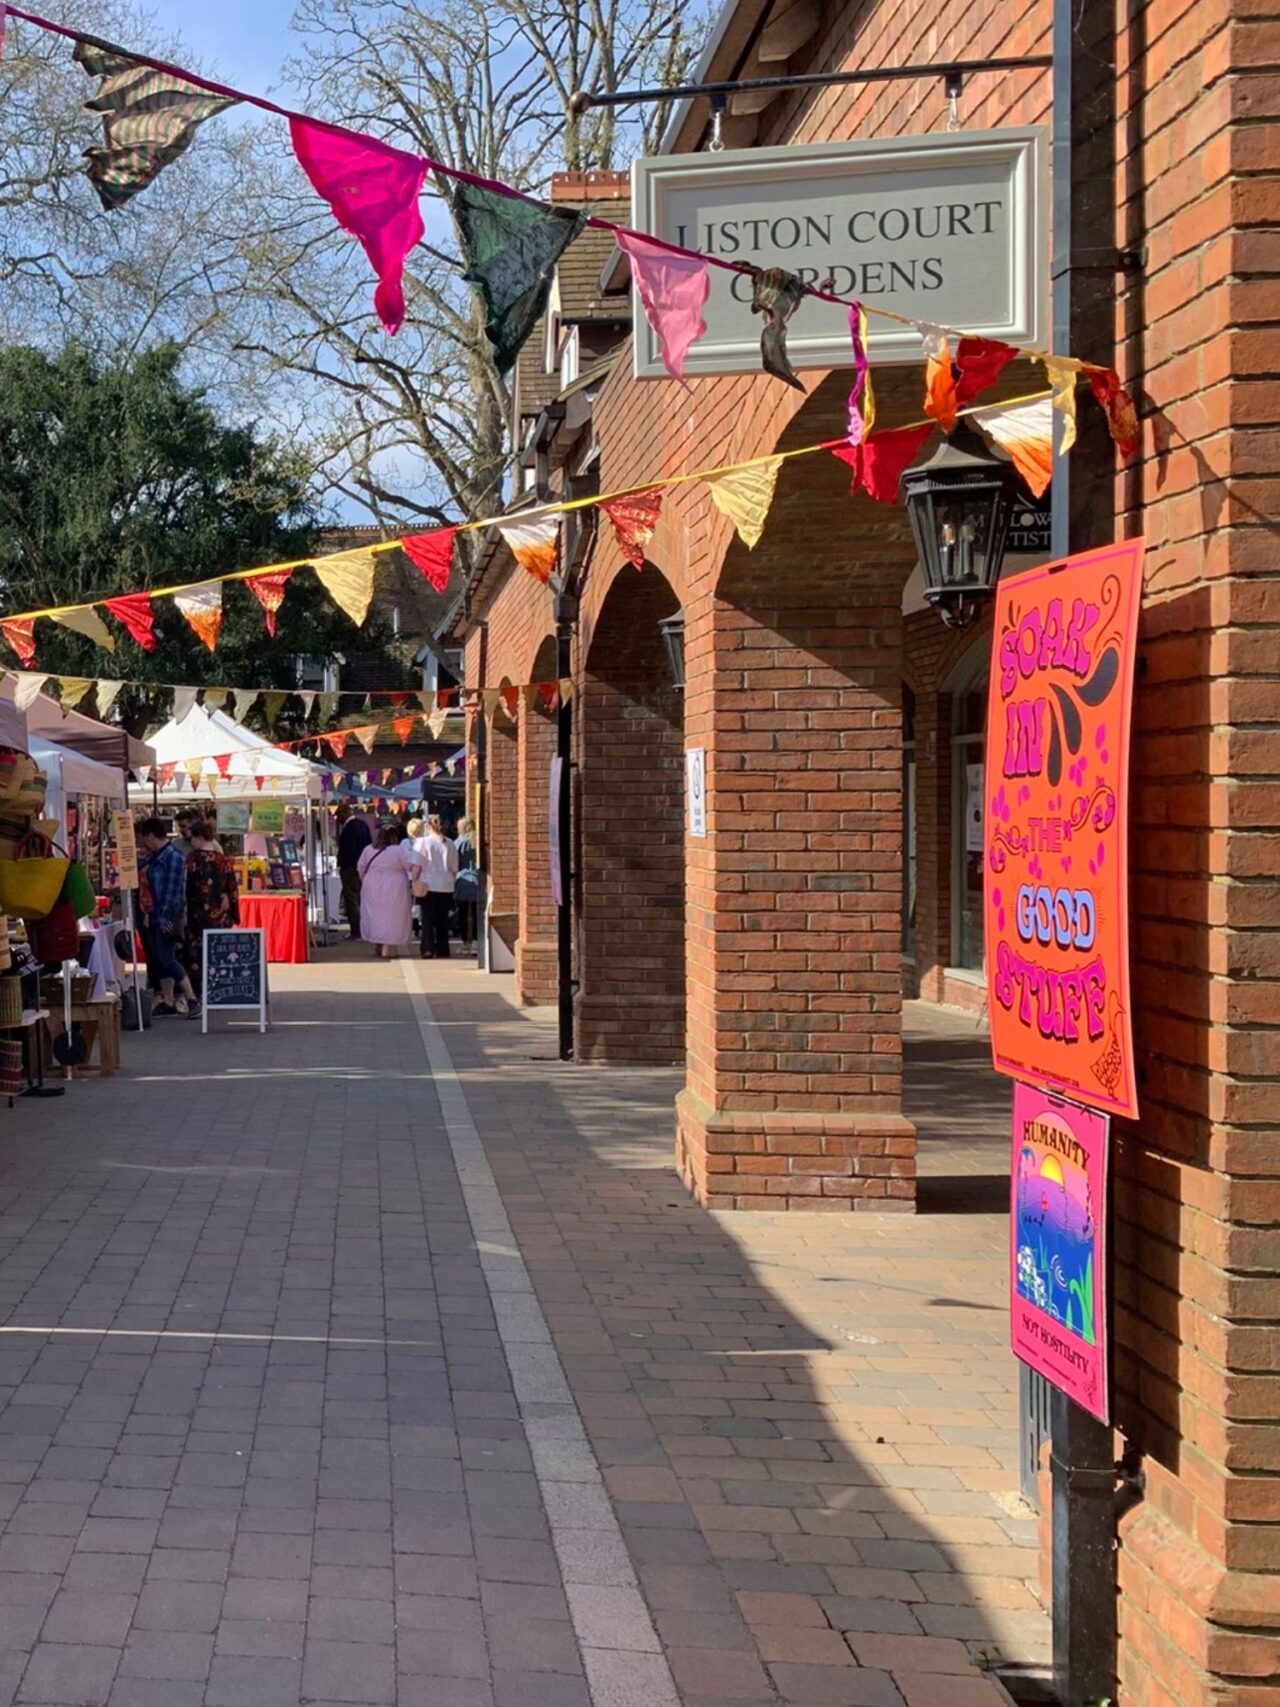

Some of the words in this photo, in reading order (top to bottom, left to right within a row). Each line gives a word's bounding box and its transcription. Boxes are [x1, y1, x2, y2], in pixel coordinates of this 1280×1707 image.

[676, 215, 834, 254] LISTON
[848, 201, 1002, 243] COURT
[730, 257, 944, 303] GRDENS
[1000, 598, 1100, 699] SOAK
[1003, 697, 1046, 779] IN
[1027, 817, 1062, 853] THE
[1016, 884, 1096, 950] GOOD
[995, 940, 1105, 1043] STUFF
[1023, 1120, 1090, 1170] HUMANITY
